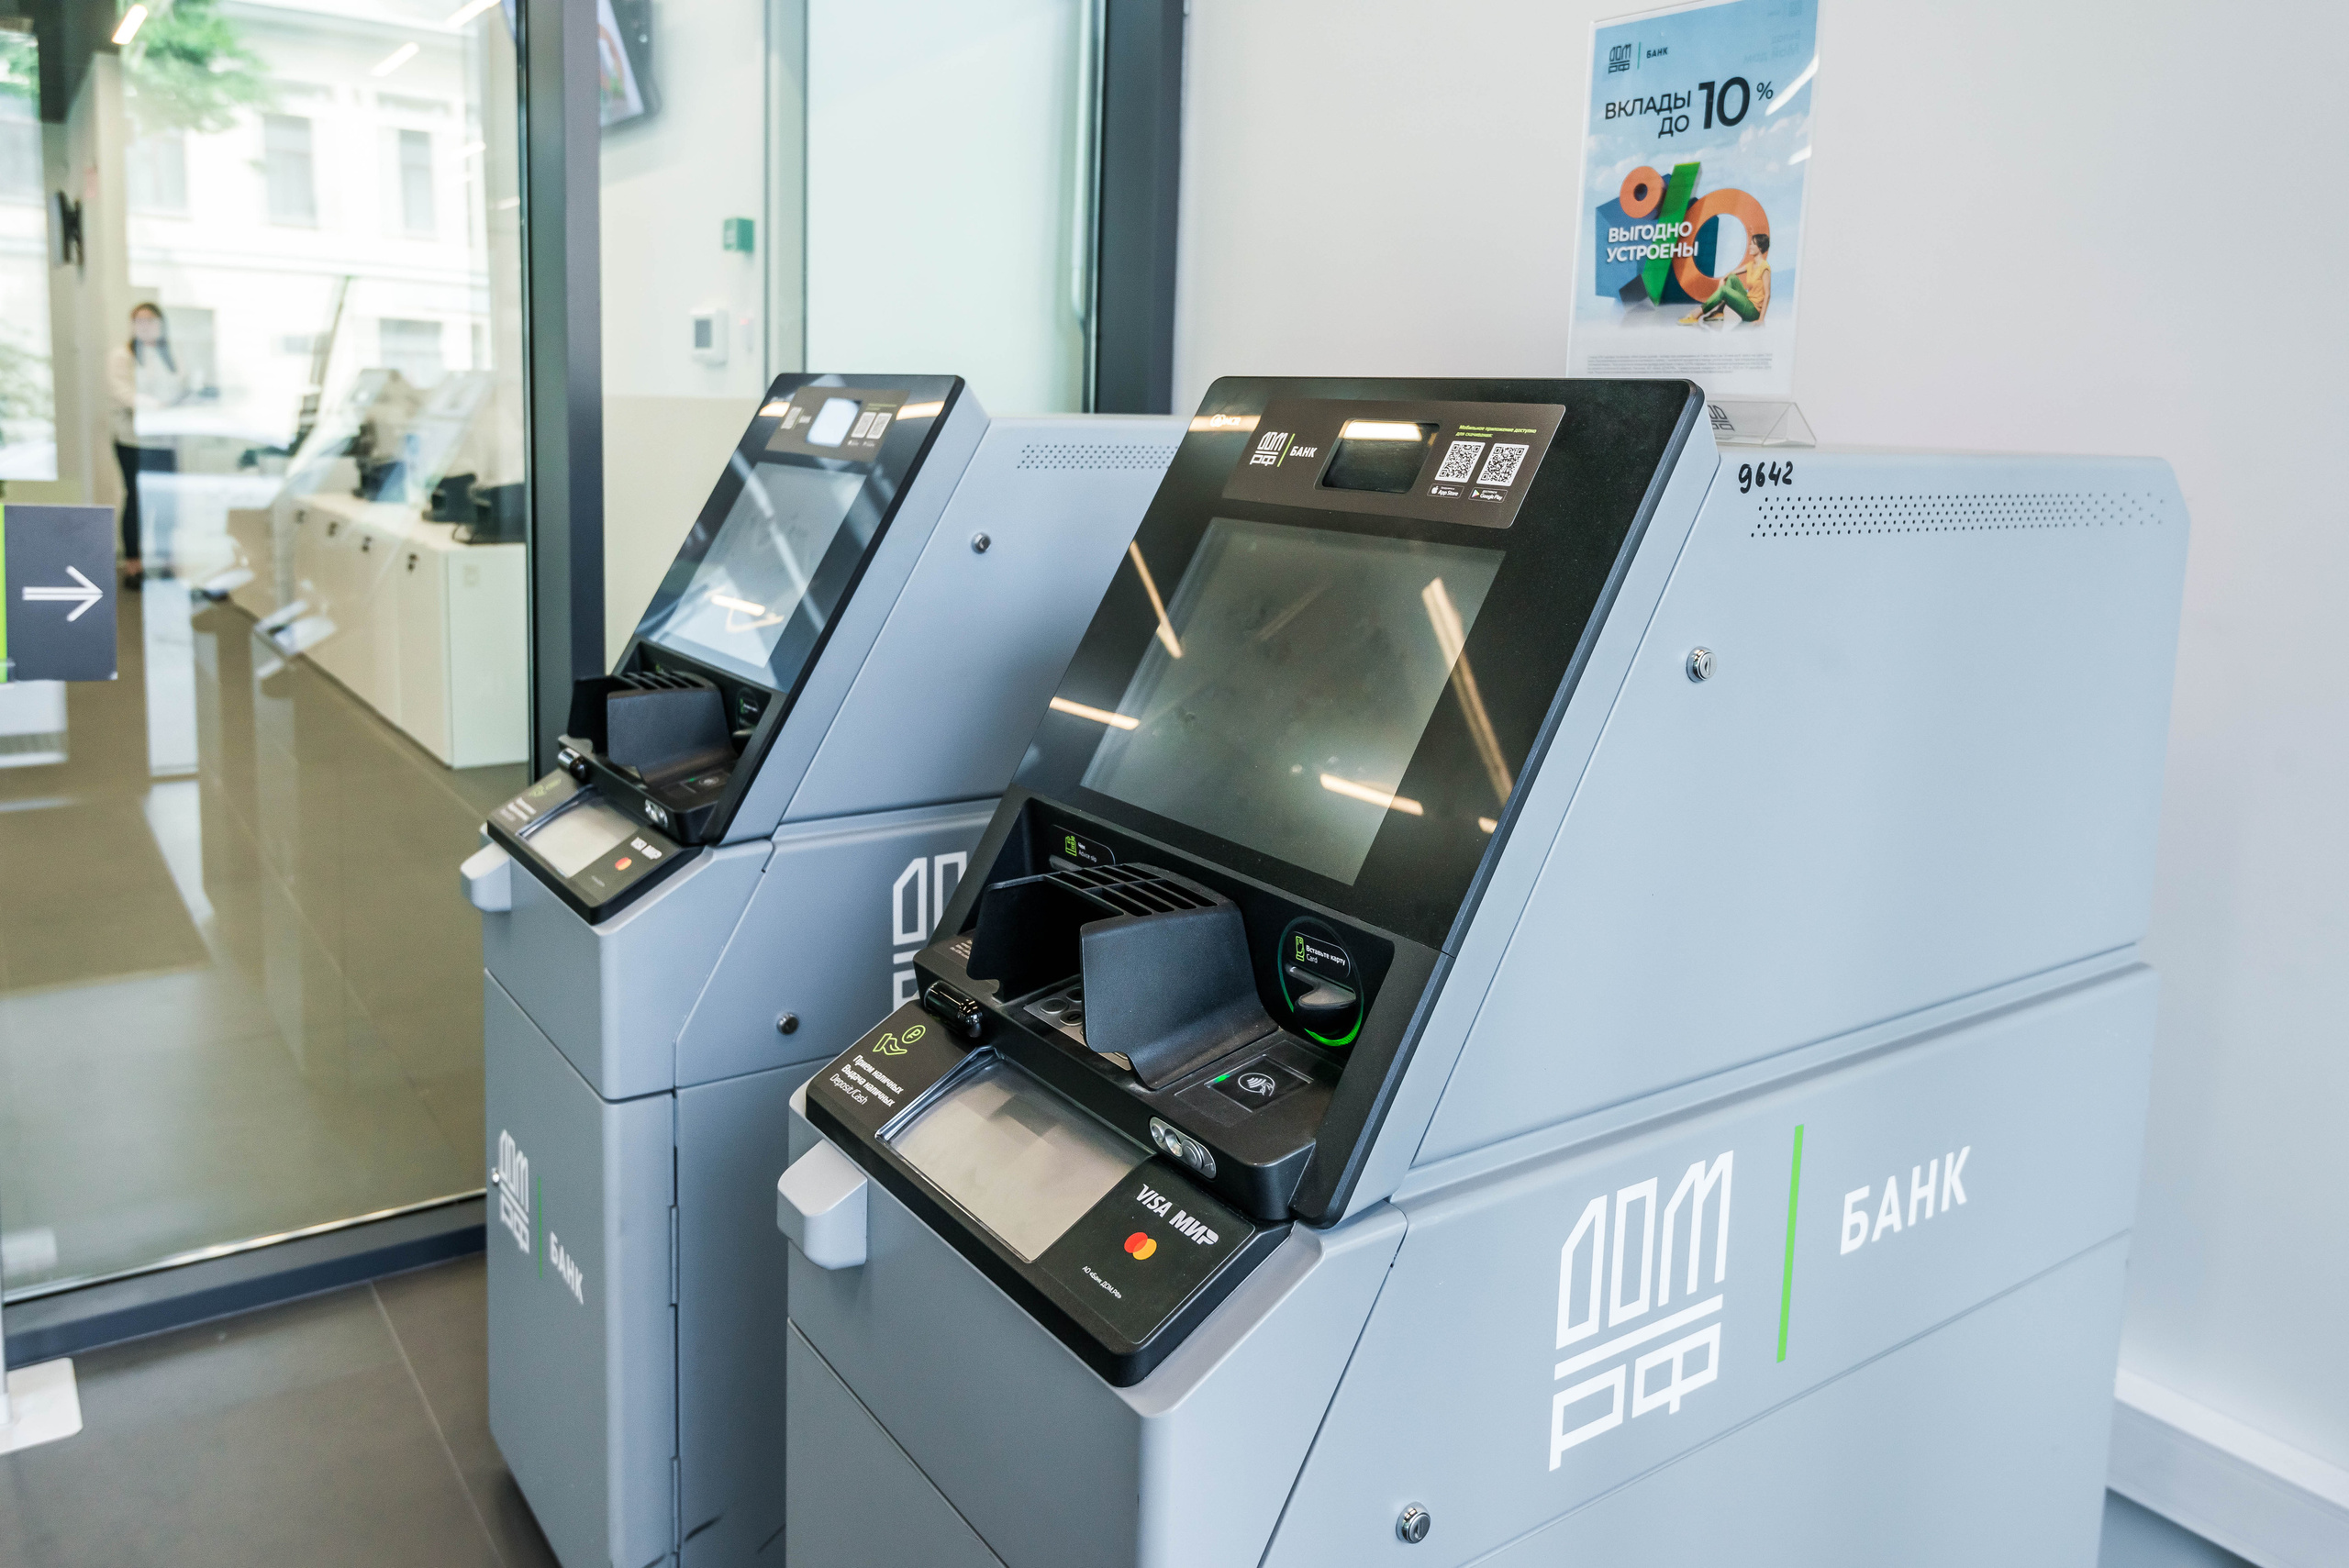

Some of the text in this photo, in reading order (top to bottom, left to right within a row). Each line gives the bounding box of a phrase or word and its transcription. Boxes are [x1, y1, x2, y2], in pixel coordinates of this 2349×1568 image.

[1608, 62, 1631, 74] РФ
[1609, 43, 1631, 62] ДОМ
[1646, 47, 1668, 59] БАНК
[1605, 90, 1691, 120] ВКЛАДЫ
[1658, 114, 1690, 139] ДО
[1608, 221, 1693, 243] ВЫГОДНО
[1607, 241, 1699, 263] УСТРОЕНЫ
[1257, 431, 1288, 451] ДОМ
[1289, 446, 1318, 458] БАНК
[1249, 454, 1277, 466] РФ
[1738, 461, 1793, 494] 9642
[893, 851, 967, 946] ДО
[1306, 945, 1346, 966] Вставьте карту
[1306, 954, 1318, 963] Card
[829, 1073, 868, 1105] Deposit/Cash
[841, 1063, 896, 1107] Выдача наличных
[852, 1054, 904, 1095] Прием наличных
[498, 1129, 529, 1213] ДОМ
[1135, 1183, 1219, 1246] VISA МИР
[1840, 1145, 1971, 1256] БАНК
[500, 1193, 529, 1254] РФ
[1555, 1150, 1734, 1351] ДОМ
[550, 1230, 584, 1306] БАНК
[1549, 1321, 1722, 1472] РФ
